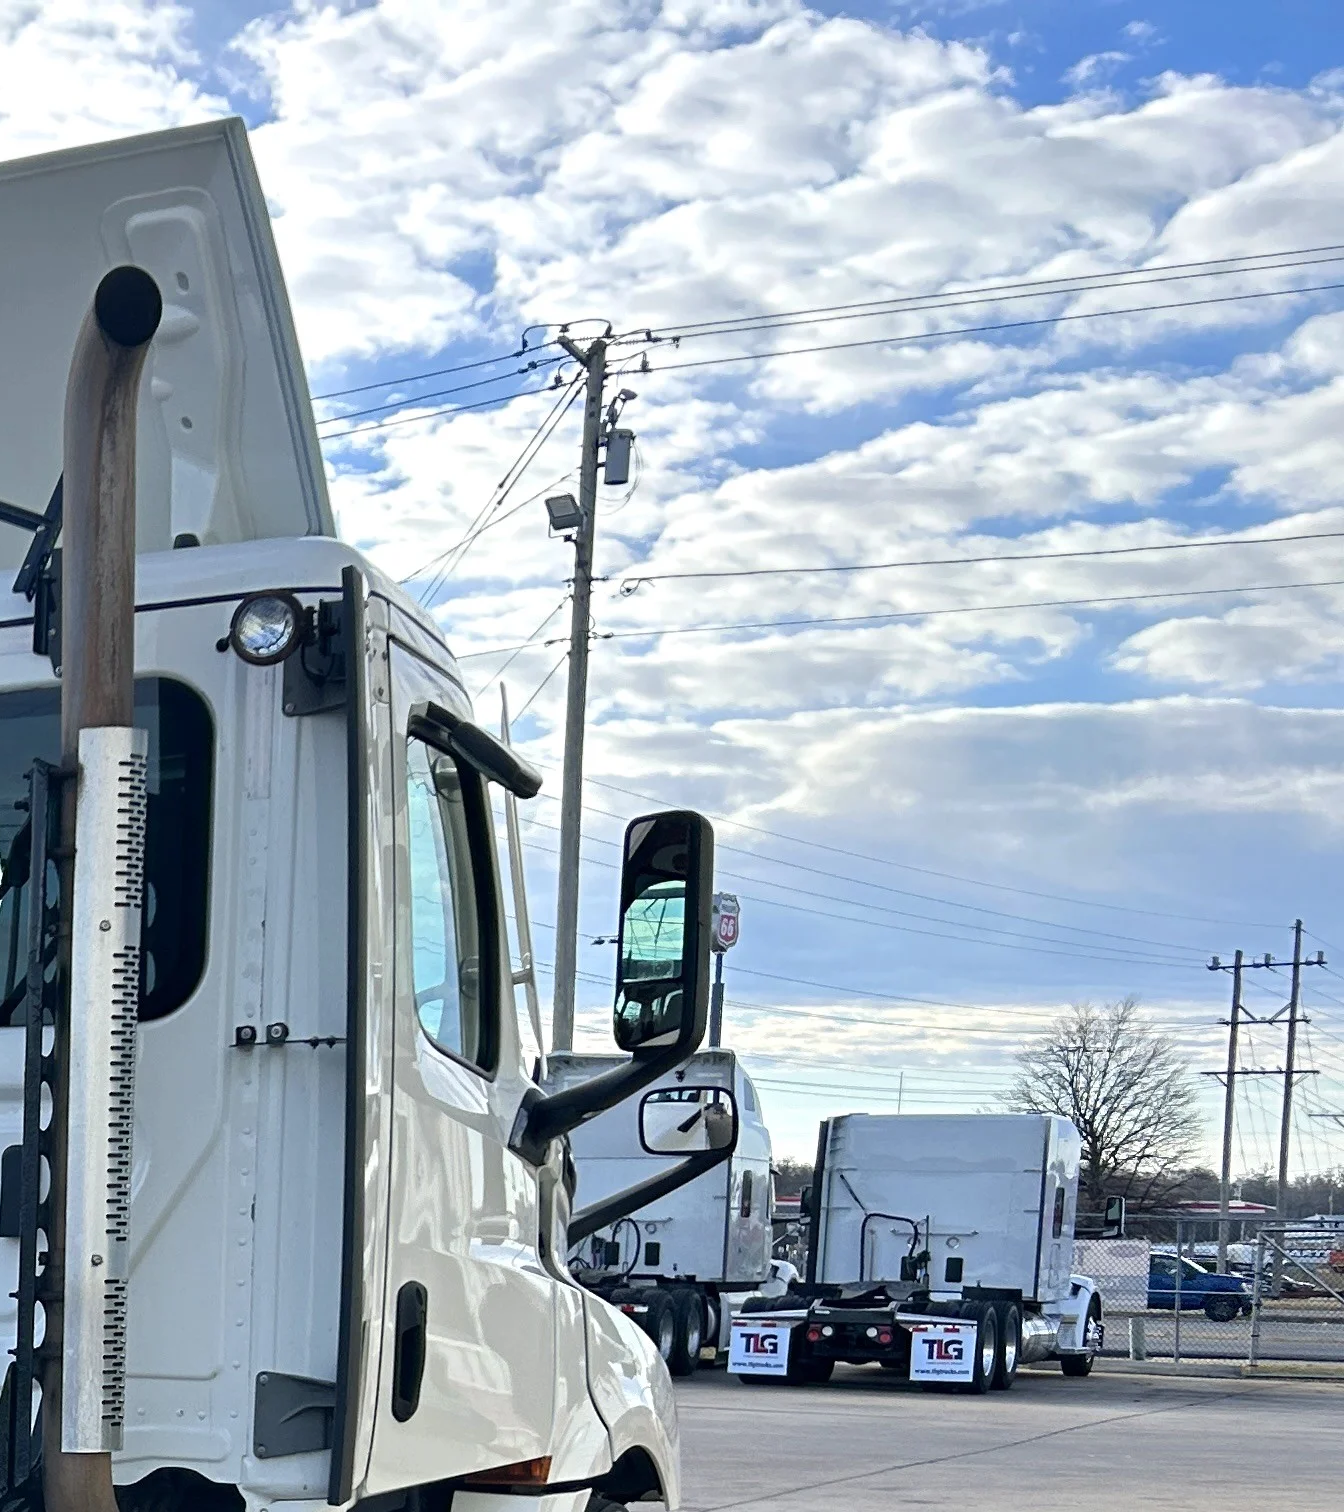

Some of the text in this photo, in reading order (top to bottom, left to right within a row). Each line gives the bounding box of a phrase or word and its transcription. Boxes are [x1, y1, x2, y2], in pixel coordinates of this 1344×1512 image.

[721, 917, 734, 937] 66
[740, 1332, 778, 1355] TLG
[922, 1338, 963, 1360] TLG
